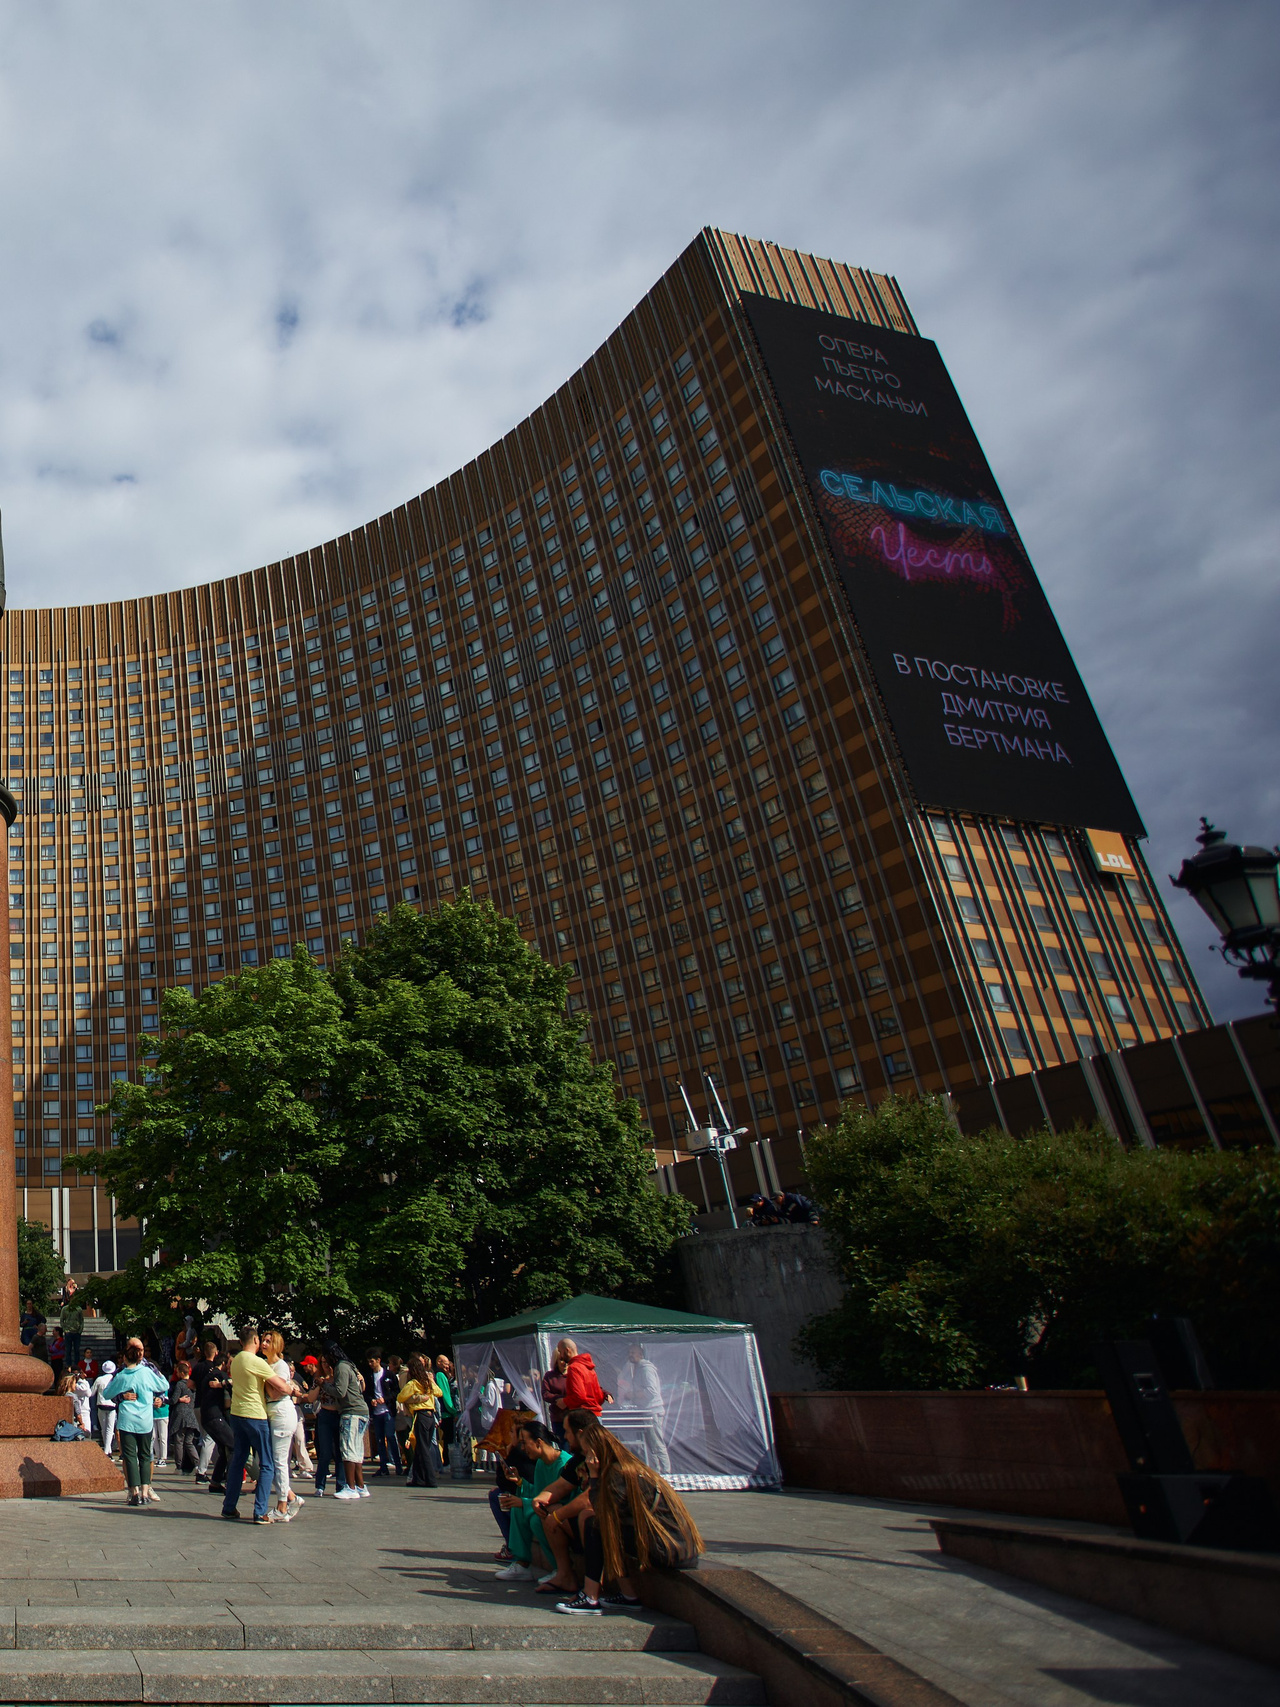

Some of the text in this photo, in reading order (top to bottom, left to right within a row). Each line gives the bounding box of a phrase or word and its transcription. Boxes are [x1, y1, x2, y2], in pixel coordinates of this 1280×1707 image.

[818, 334, 889, 366] ОПЕРА
[822, 356, 902, 390] ПЬЕТРО
[814, 375, 929, 418] МАСКАНЬИ
[820, 469, 1006, 533] СЕЛЬСКАЯ
[870, 522, 993, 581] Честь
[892, 653, 1071, 704] В ПОСТАНОВКЕ
[941, 692, 1052, 730] ДМИТРИЯ
[943, 723, 1072, 765] БЕРТМАНА
